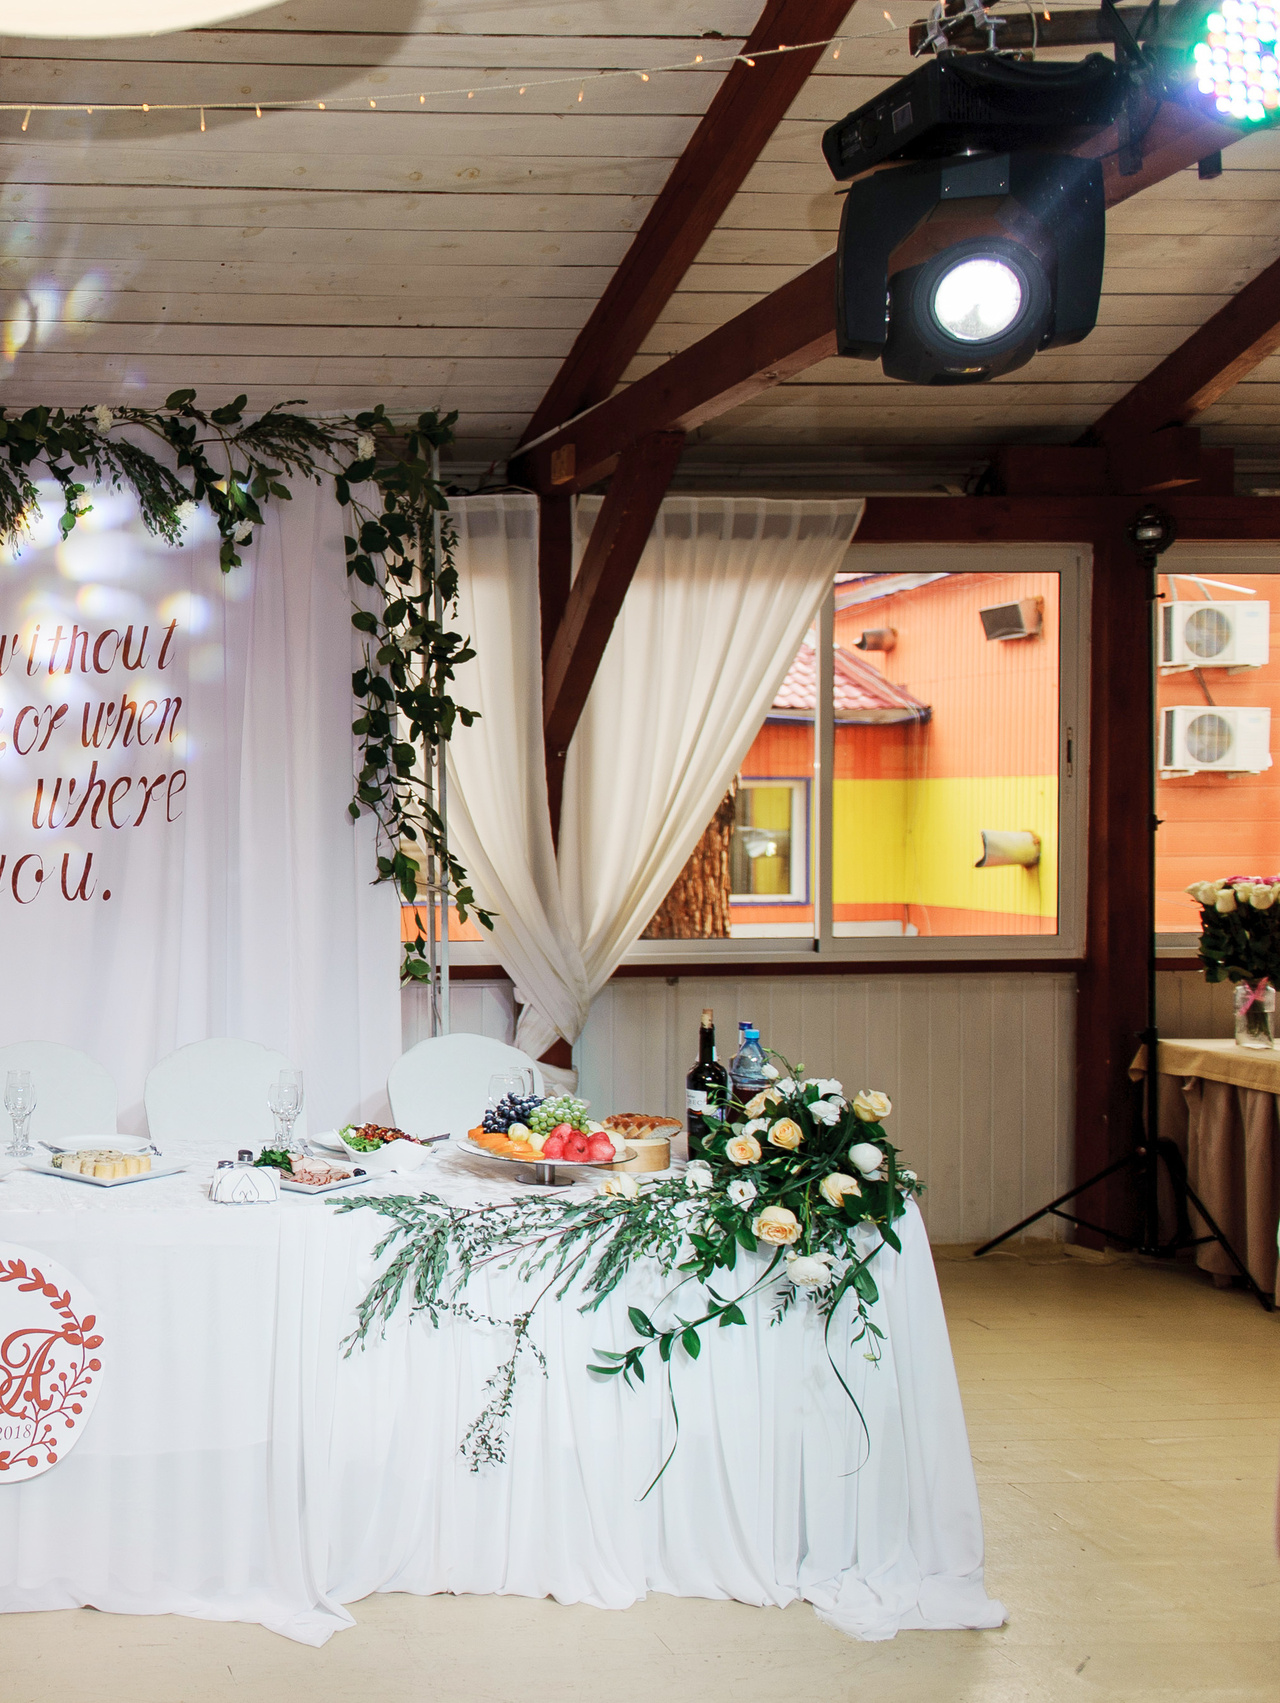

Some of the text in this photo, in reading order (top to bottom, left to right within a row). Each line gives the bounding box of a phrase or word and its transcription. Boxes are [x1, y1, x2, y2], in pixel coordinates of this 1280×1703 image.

[12, 703, 67, 756] or
[81, 693, 183, 750] when
[31, 761, 188, 829] where
